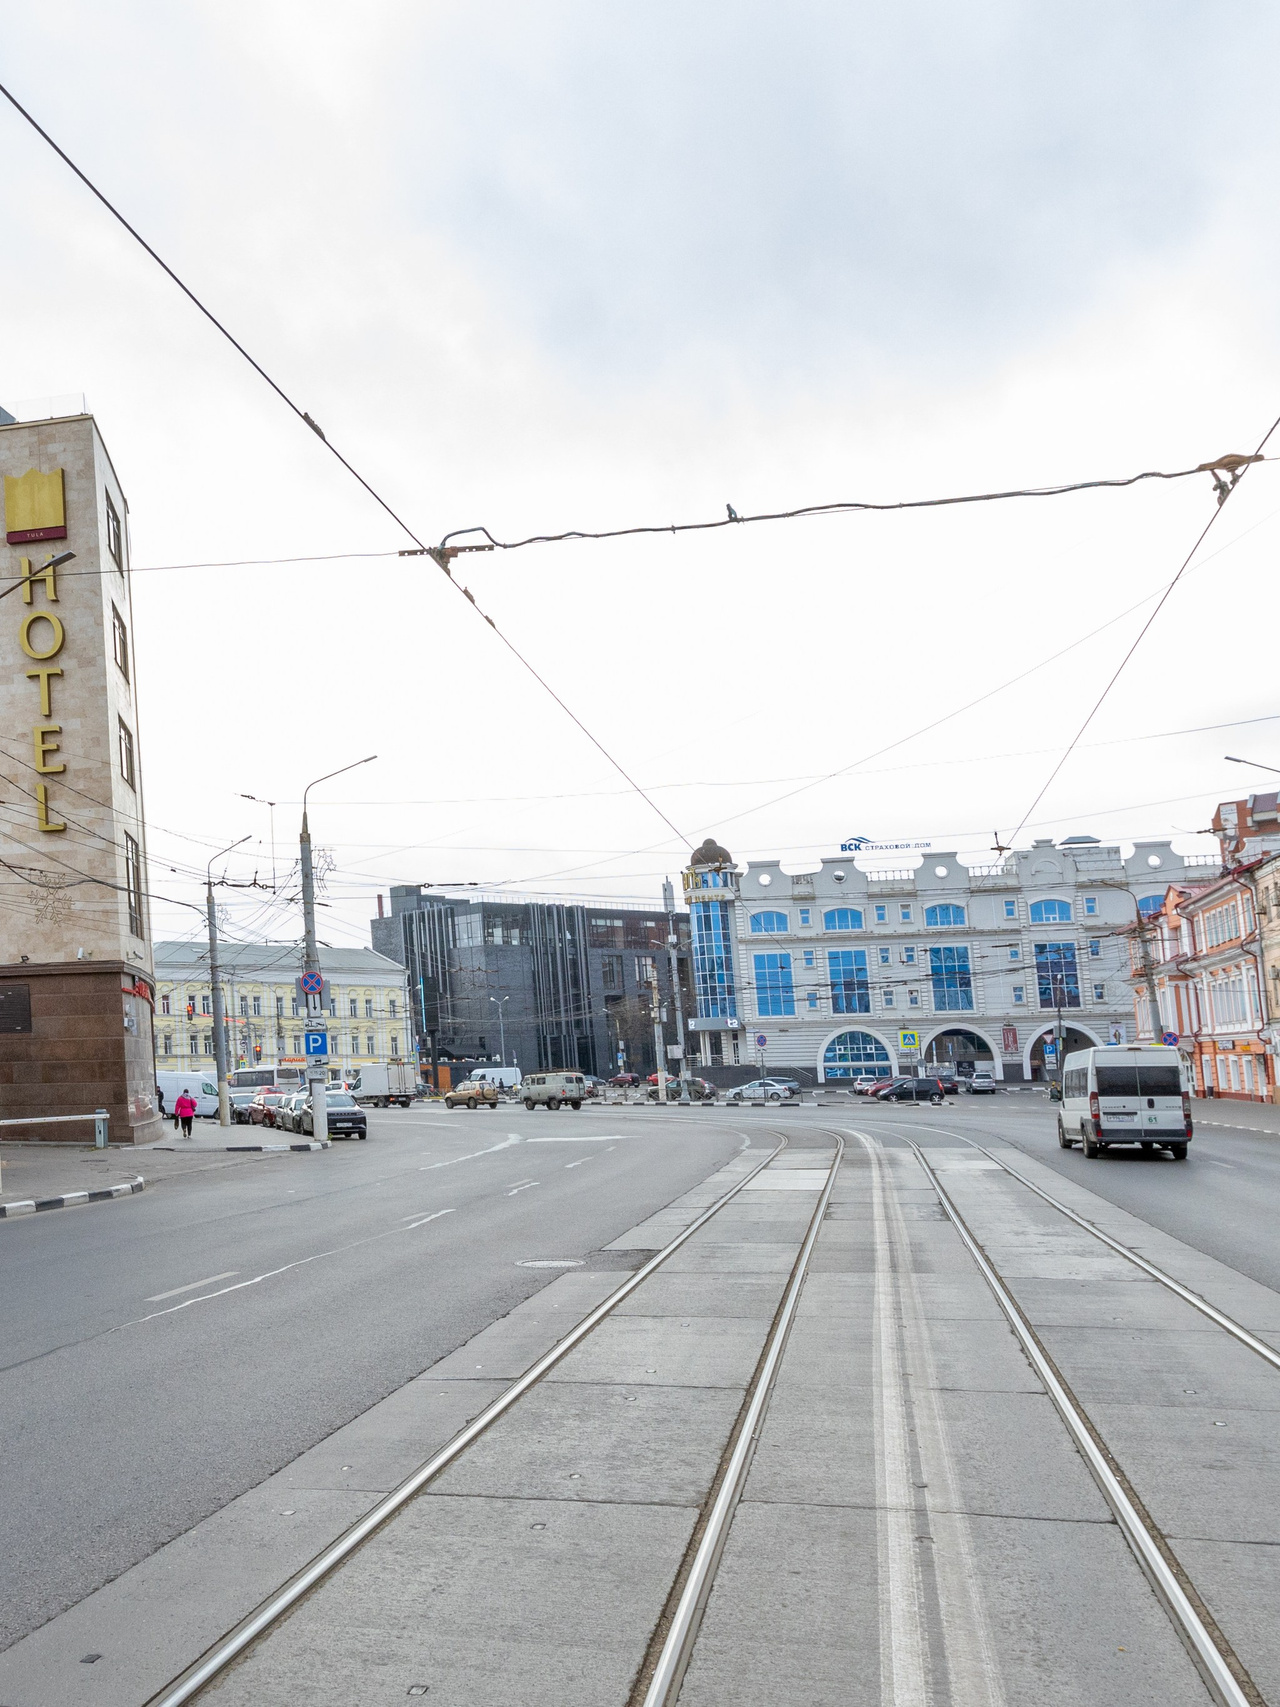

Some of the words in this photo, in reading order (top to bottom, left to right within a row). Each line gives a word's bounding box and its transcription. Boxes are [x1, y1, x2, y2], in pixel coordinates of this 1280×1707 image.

[19, 553, 67, 833] HOTEL
[840, 843, 862, 852] ВСК
[864, 843, 911, 851] СТРАХОВОЙ
[727, 1018, 738, 1028] t2
[309, 1035, 322, 1053] P
